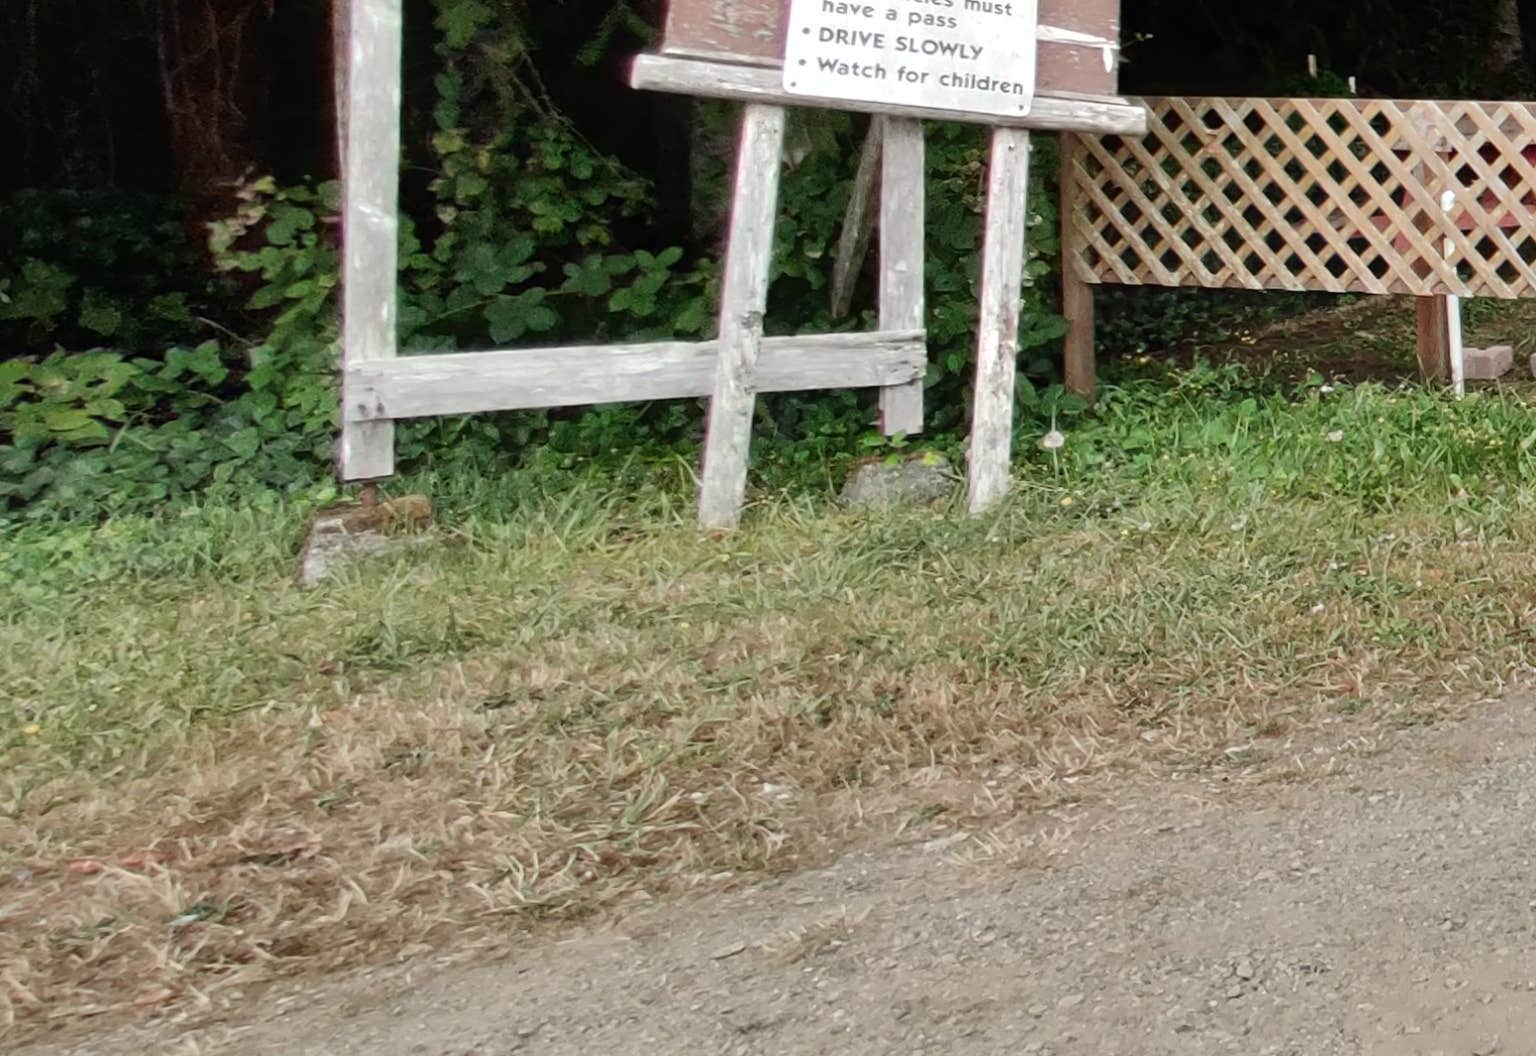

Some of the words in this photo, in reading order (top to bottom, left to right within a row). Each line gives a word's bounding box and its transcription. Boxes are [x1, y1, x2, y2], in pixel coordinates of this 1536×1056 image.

[886, 9, 897, 21] a
[908, 12, 957, 29] pass
[964, 0, 1012, 16] must
[819, 27, 885, 49] DRIVE
[895, 36, 983, 60] SLOWLY
[817, 57, 886, 79] Watch
[897, 66, 929, 83] for
[939, 72, 1023, 95] children
